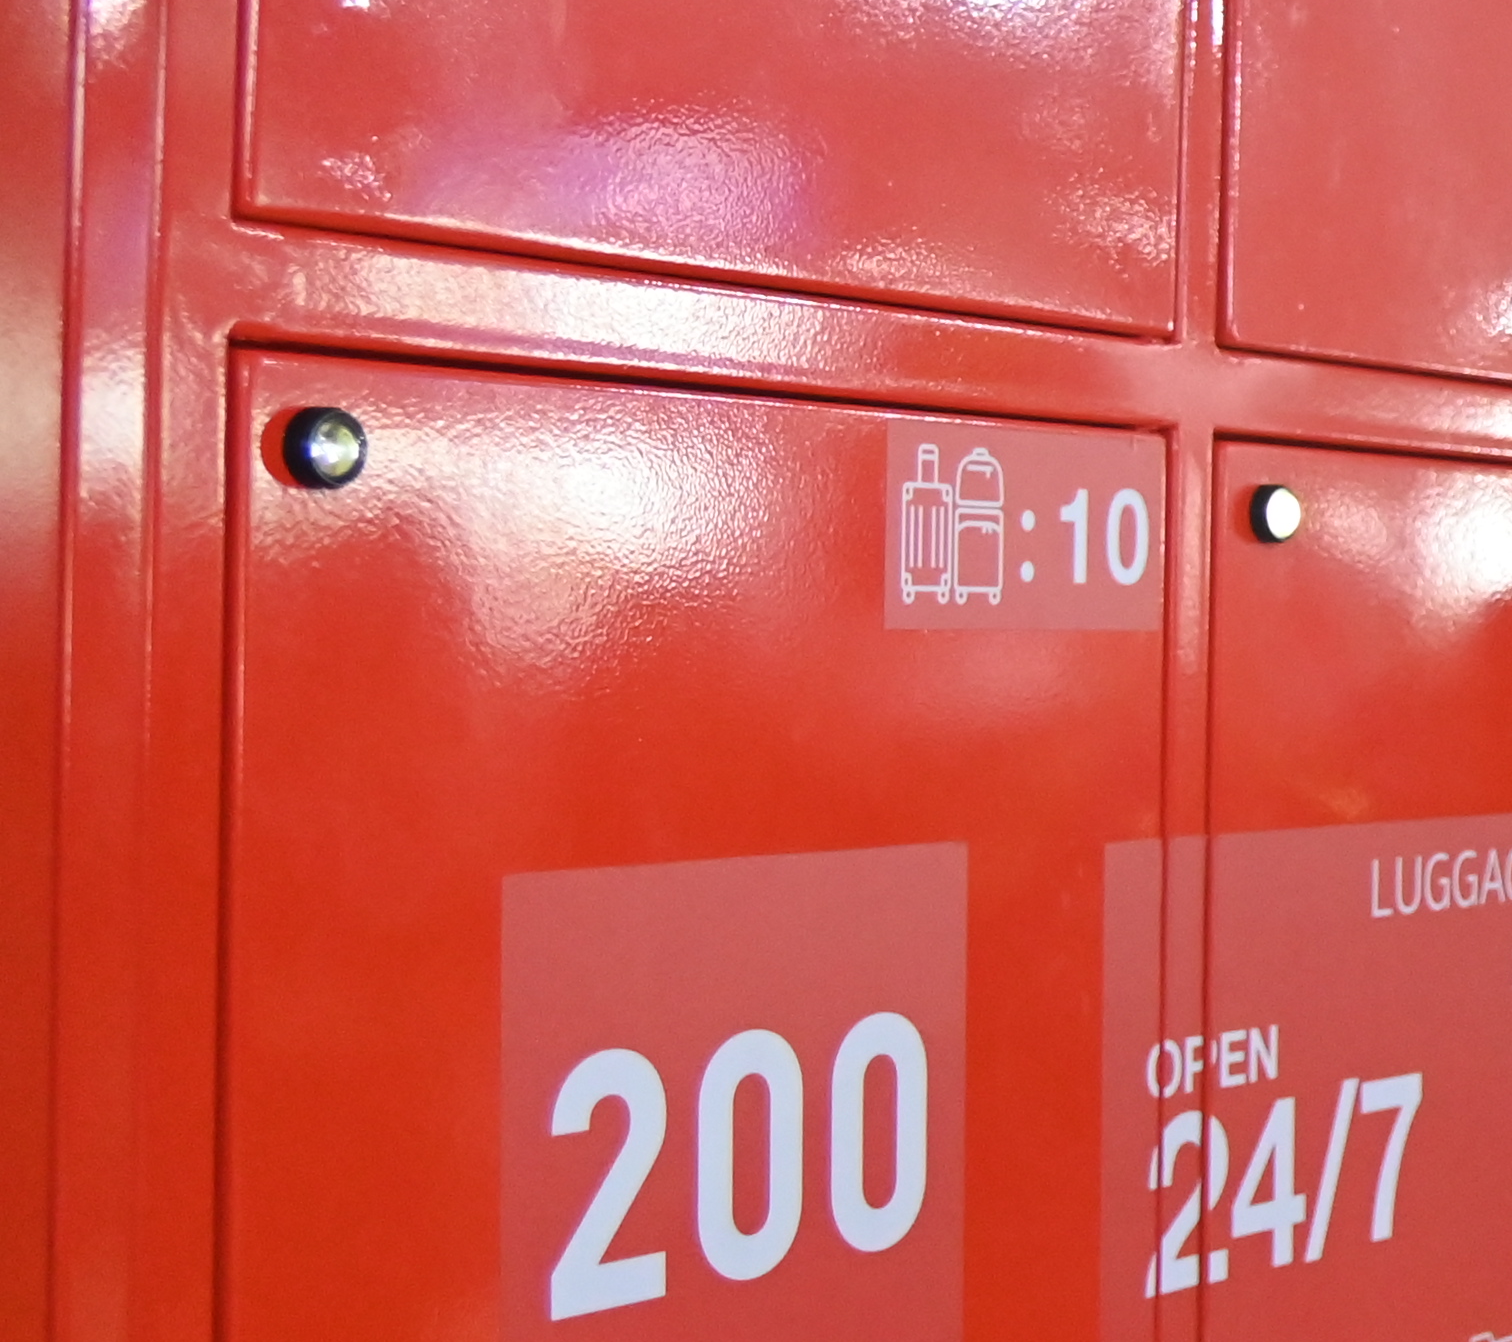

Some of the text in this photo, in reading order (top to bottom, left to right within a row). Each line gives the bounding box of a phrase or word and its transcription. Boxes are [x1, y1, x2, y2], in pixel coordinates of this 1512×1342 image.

[549, 1010, 929, 1323] 200
[1145, 1023, 1280, 1099] OPEN
[1143, 1070, 1424, 1300] 24/7
